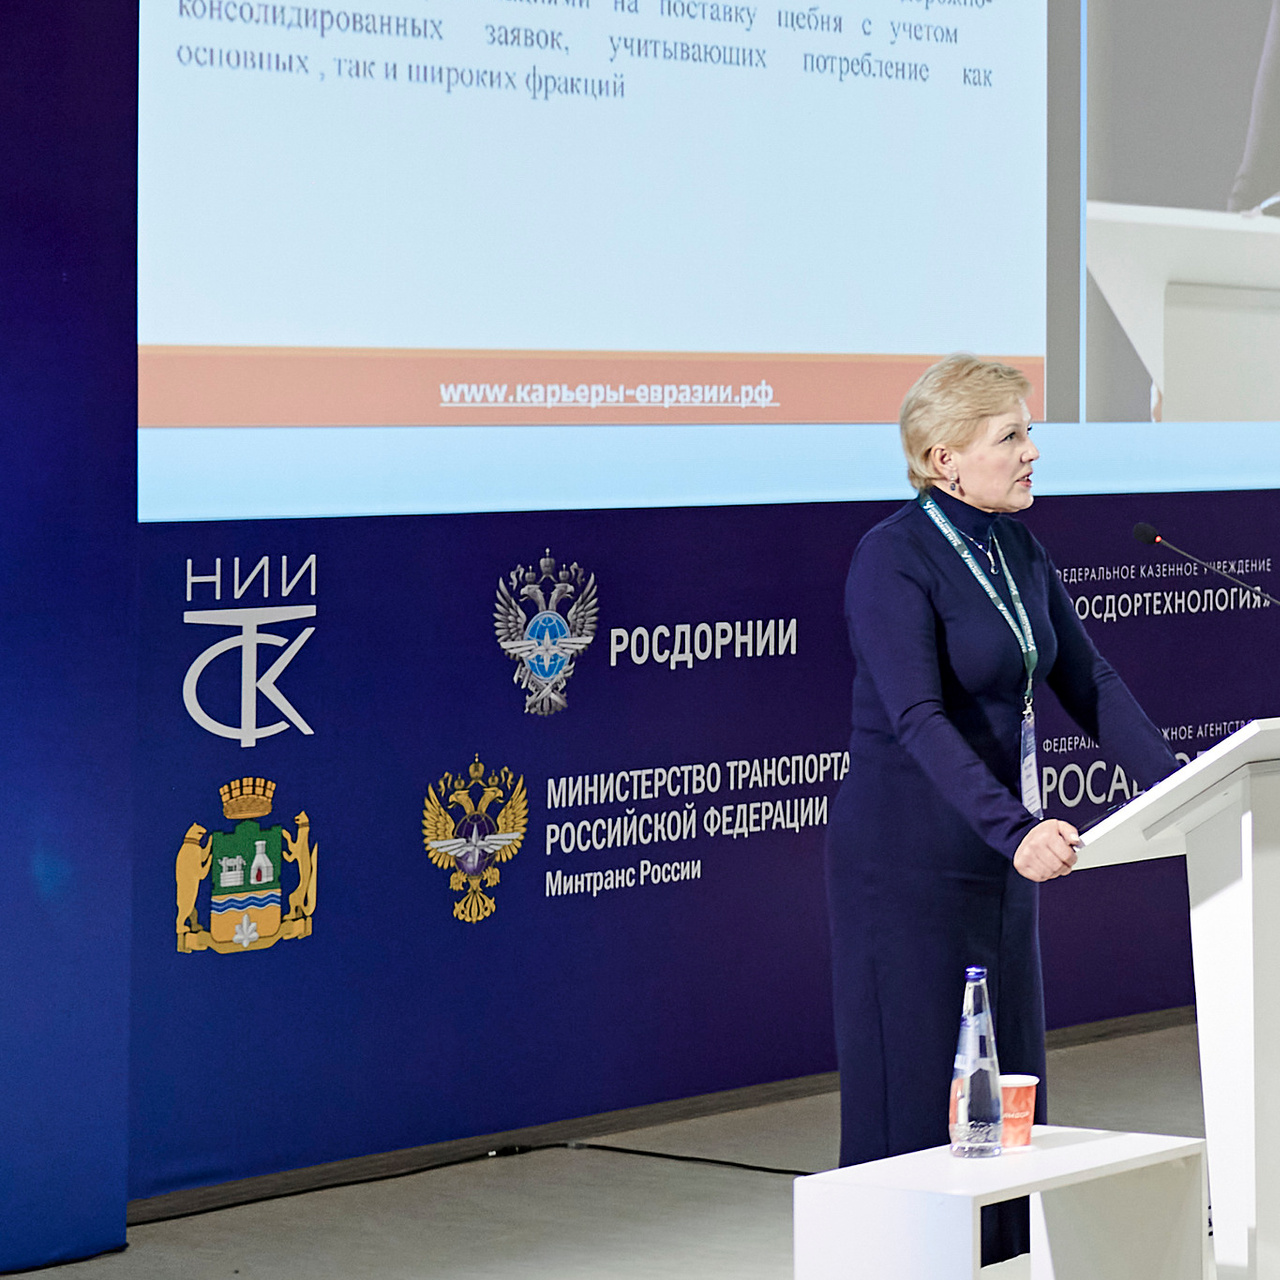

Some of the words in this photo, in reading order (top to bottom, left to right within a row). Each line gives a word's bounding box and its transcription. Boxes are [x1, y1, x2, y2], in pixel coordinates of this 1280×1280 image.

[778, 7, 843, 34] щебня
[861, 18, 872, 36] с
[890, 20, 958, 44] учетом
[177, 44, 309, 74] основных
[333, 56, 376, 79] так
[384, 64, 398, 80] и
[407, 64, 517, 93] широких
[525, 65, 625, 99] фракций
[485, 23, 570, 55] заявок,
[608, 32, 767, 68] учитывающих
[803, 52, 930, 82] потребление
[962, 65, 992, 87] как
[439, 379, 775, 407] www.карьеры-евразии.рф
[186, 554, 317, 602] НИИ
[1139, 562, 1199, 579] КАЗЕННОЕ
[1203, 558, 1272, 575] ЧРЕЖДЕНИЕ
[1070, 586, 1270, 622] ОСДОРТЕХНОЛОГИЯ»
[609, 618, 797, 671] РОСДОРНИИ
[546, 761, 720, 810] МИНИСТЕРСТВО
[726, 751, 851, 791] ТРАНСПОРТА
[546, 801, 697, 856] РОССИЙСКОЙ
[702, 795, 828, 838] ФЕДЕРАЦИИ
[546, 864, 636, 898] Минтранс
[639, 855, 702, 886] России
